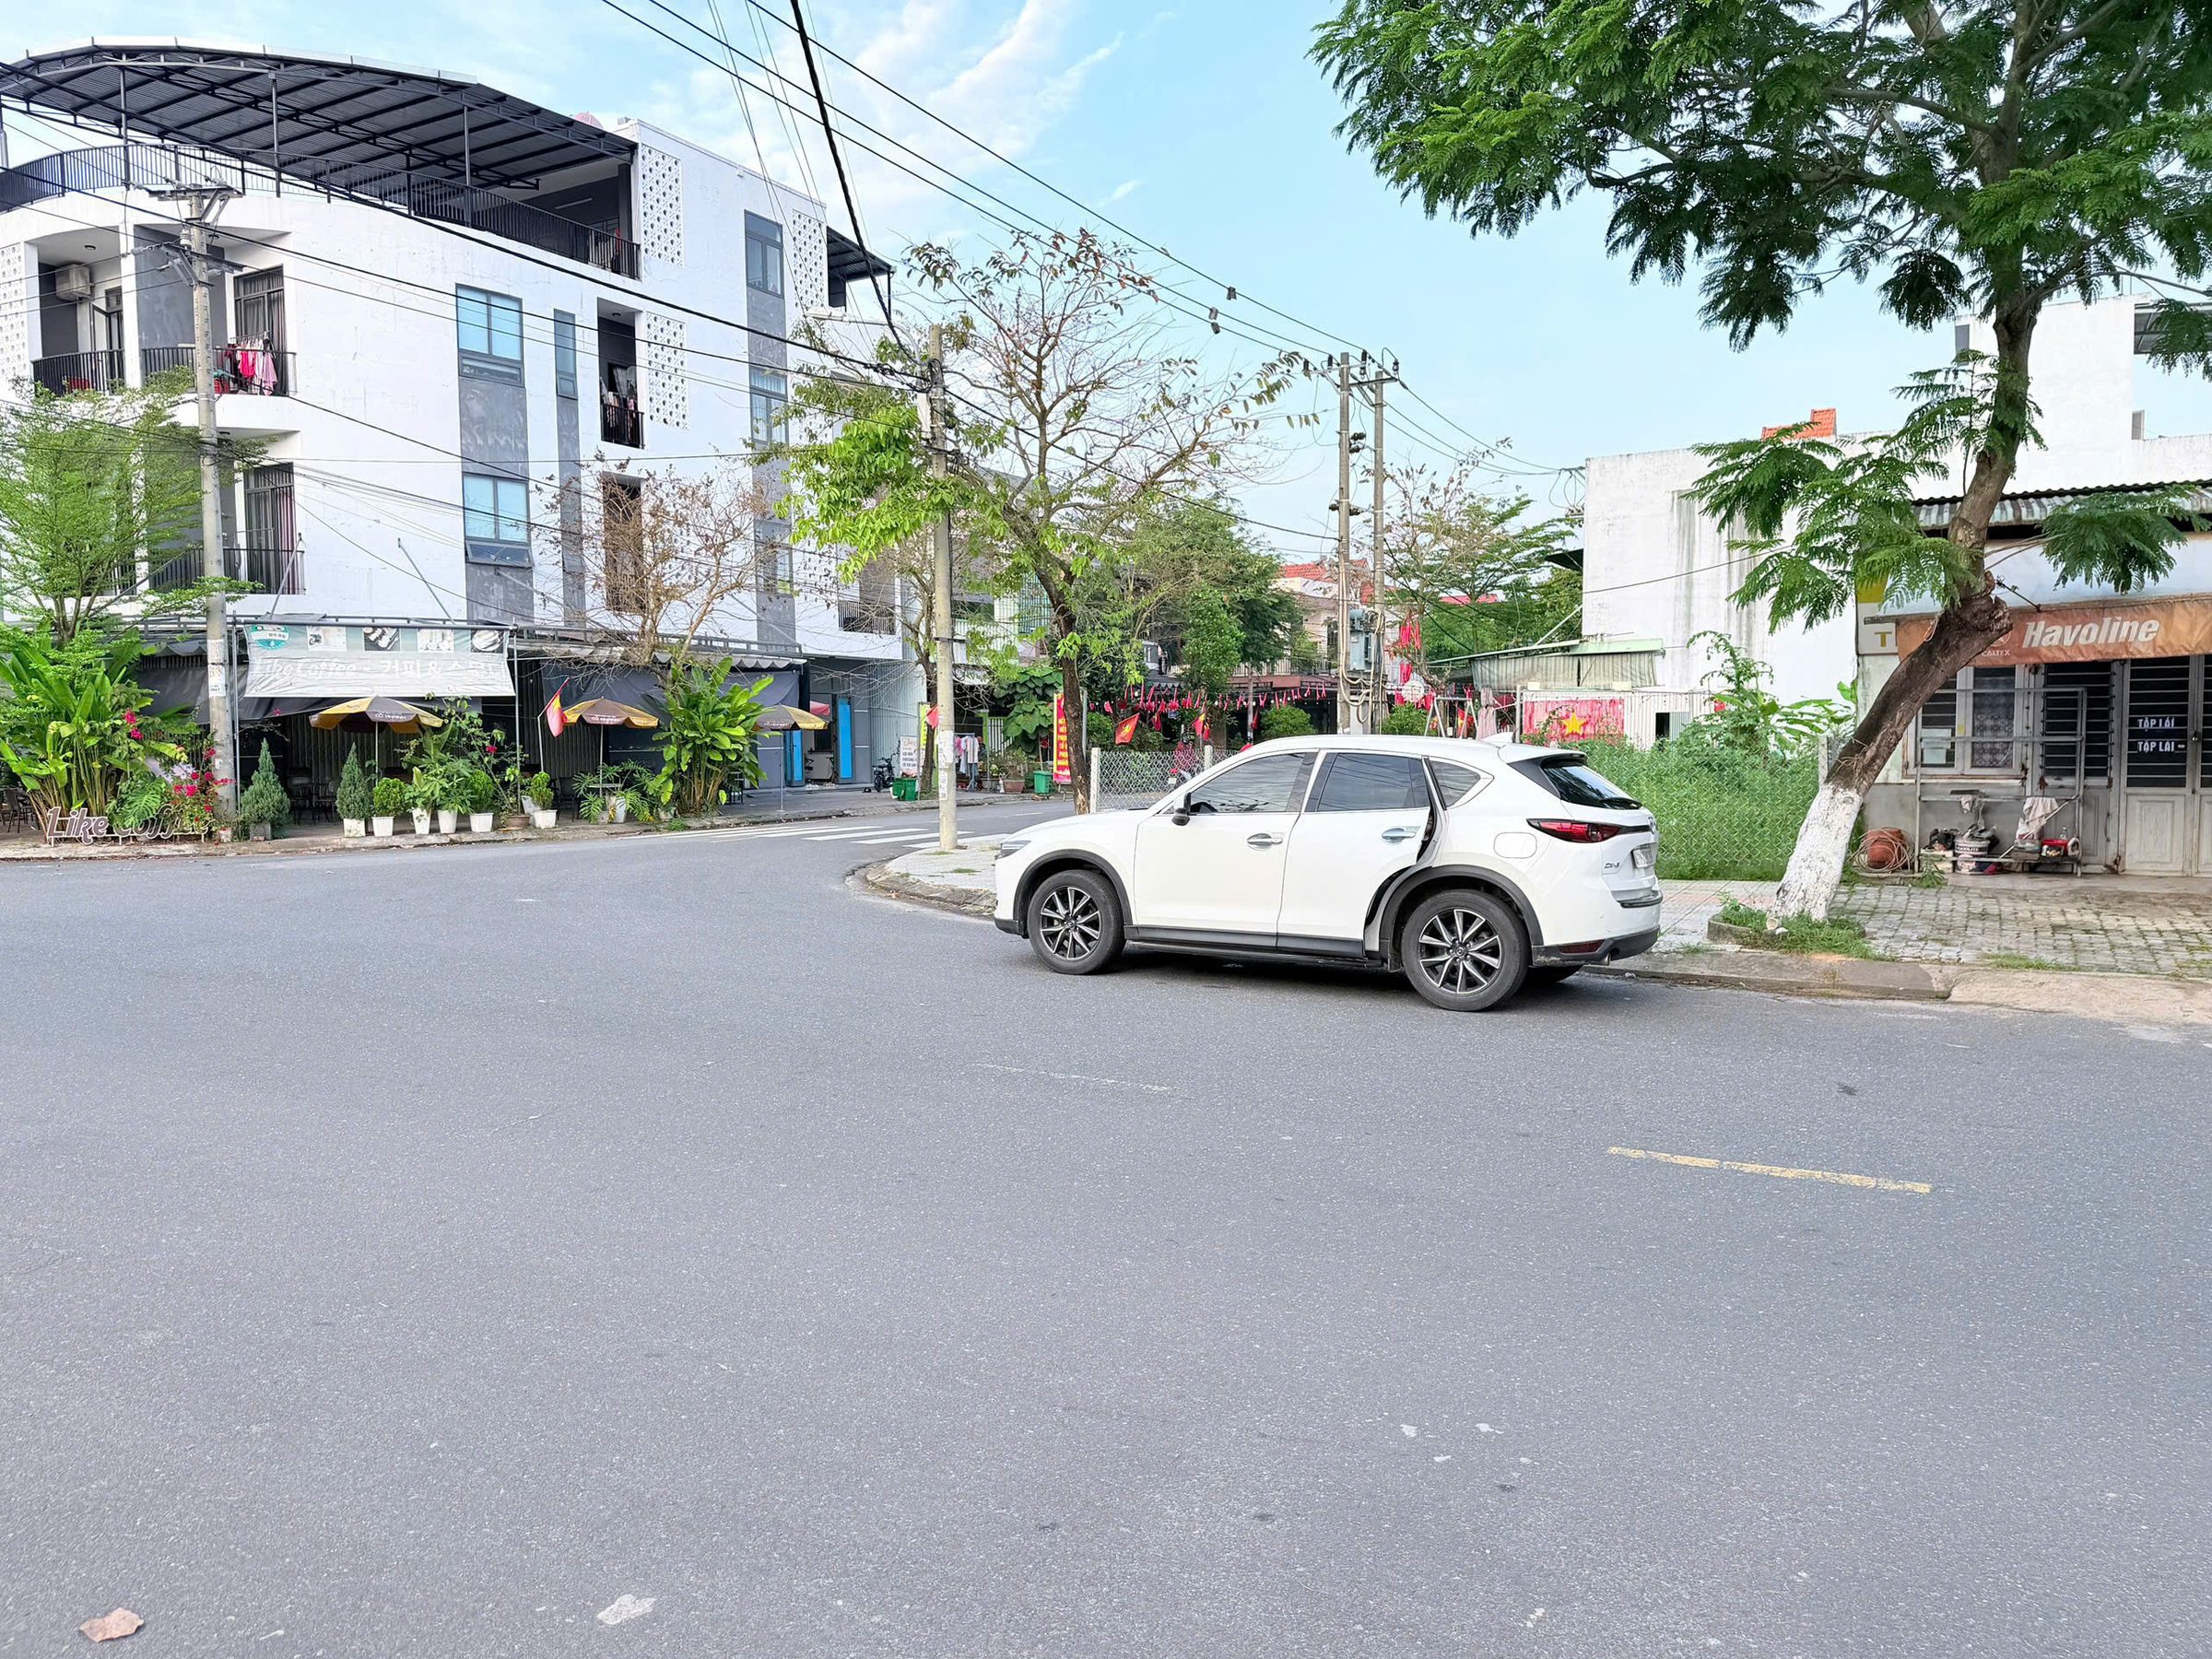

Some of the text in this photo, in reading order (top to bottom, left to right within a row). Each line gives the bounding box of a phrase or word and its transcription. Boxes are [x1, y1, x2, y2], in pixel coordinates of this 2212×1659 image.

[2021, 617, 2160, 649] Havoline
[1982, 649, 2010, 658] CALTEX
[379, 660, 421, 678] 커피
[428, 660, 441, 676] &
[2138, 717, 2158, 732] TẬP
[2138, 740, 2158, 753] TẬP
[48, 806, 110, 845] Like
